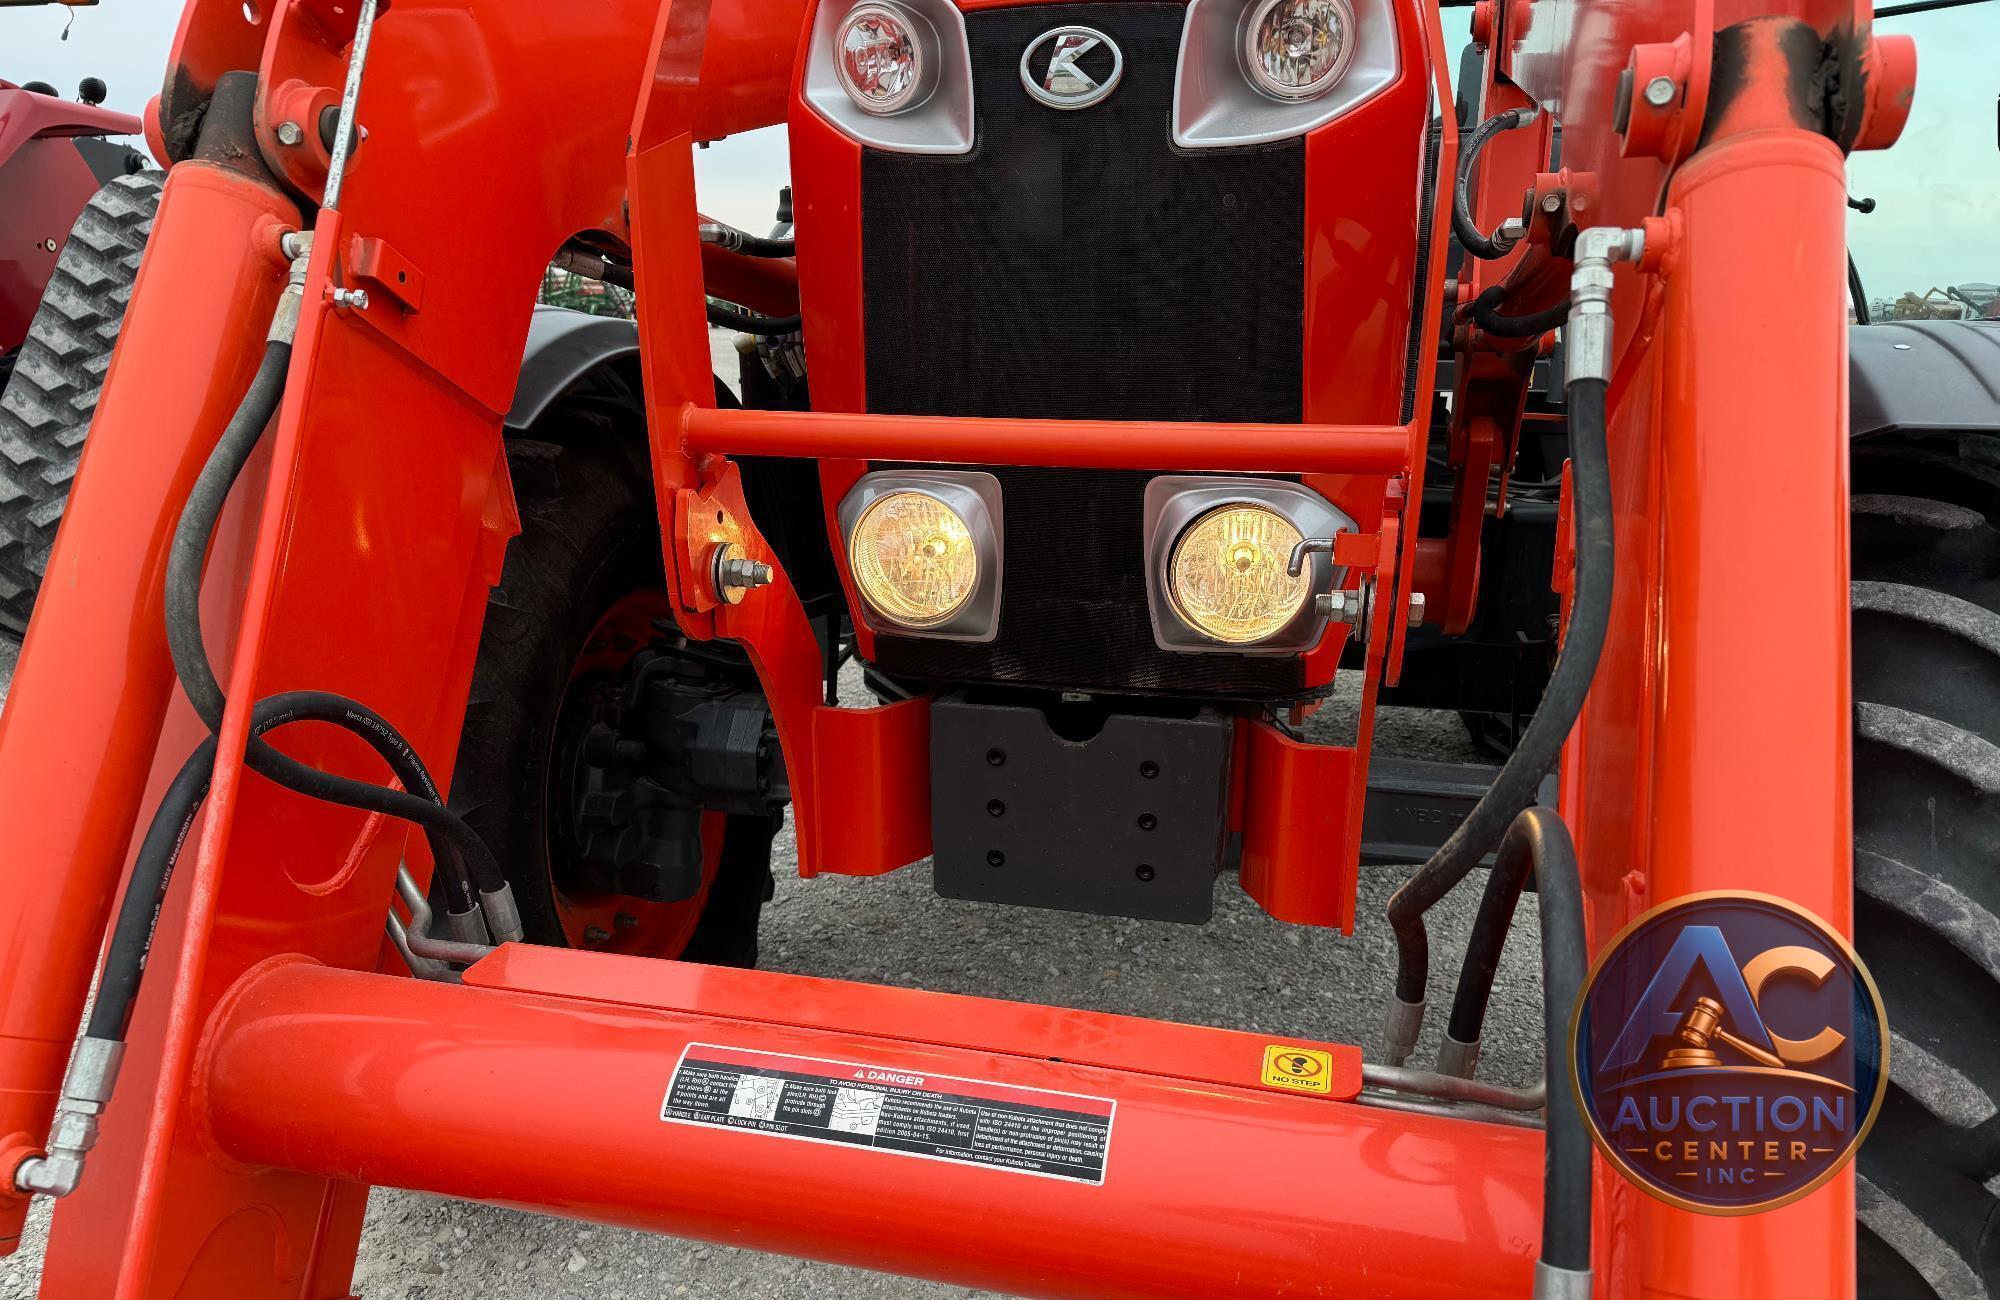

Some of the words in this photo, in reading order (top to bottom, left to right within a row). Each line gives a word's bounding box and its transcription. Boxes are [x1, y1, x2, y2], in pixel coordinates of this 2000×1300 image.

[867, 1070, 925, 1086] DANGER
[857, 1083, 888, 1092] PERSONAL
[890, 1087, 911, 1095] INJURY
[902, 1100, 933, 1108] recommends
[882, 1104, 912, 1113] attachments
[920, 1108, 937, 1116] Kubota
[893, 1121, 912, 1130] comply
[1027, 1118, 1054, 1126] attachment
[1068, 1132, 1098, 1141] positioning
[1019, 1140, 1046, 1148] attachment
